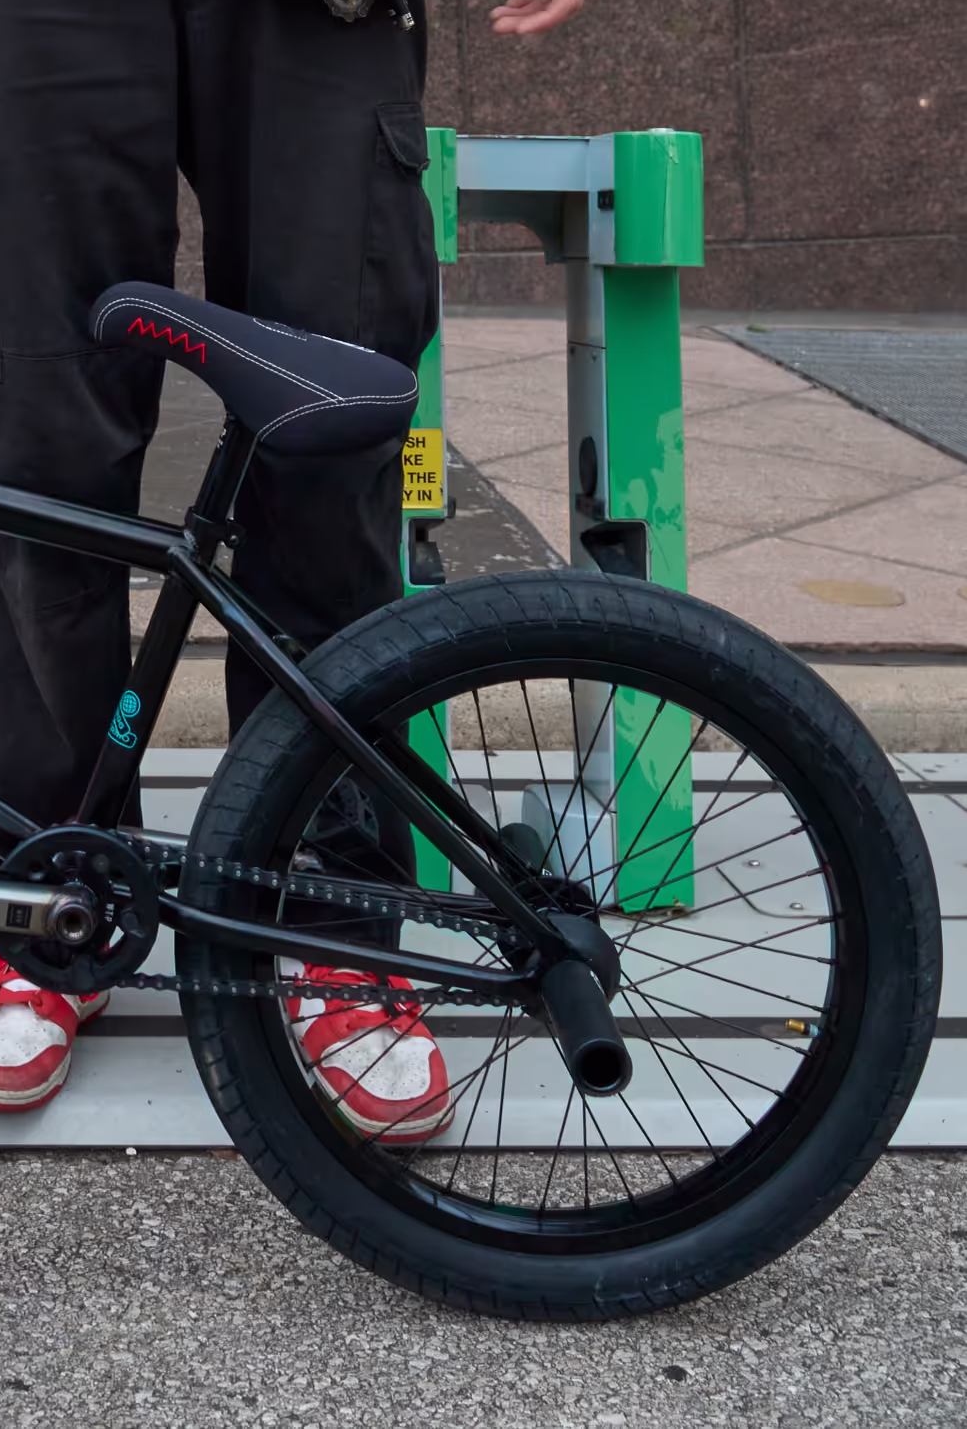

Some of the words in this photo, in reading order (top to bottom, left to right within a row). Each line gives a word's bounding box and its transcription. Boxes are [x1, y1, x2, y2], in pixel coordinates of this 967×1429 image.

[405, 436, 426, 449] SH
[403, 454, 423, 466] KE
[407, 472, 436, 484] THE
[417, 490, 432, 501] IN
